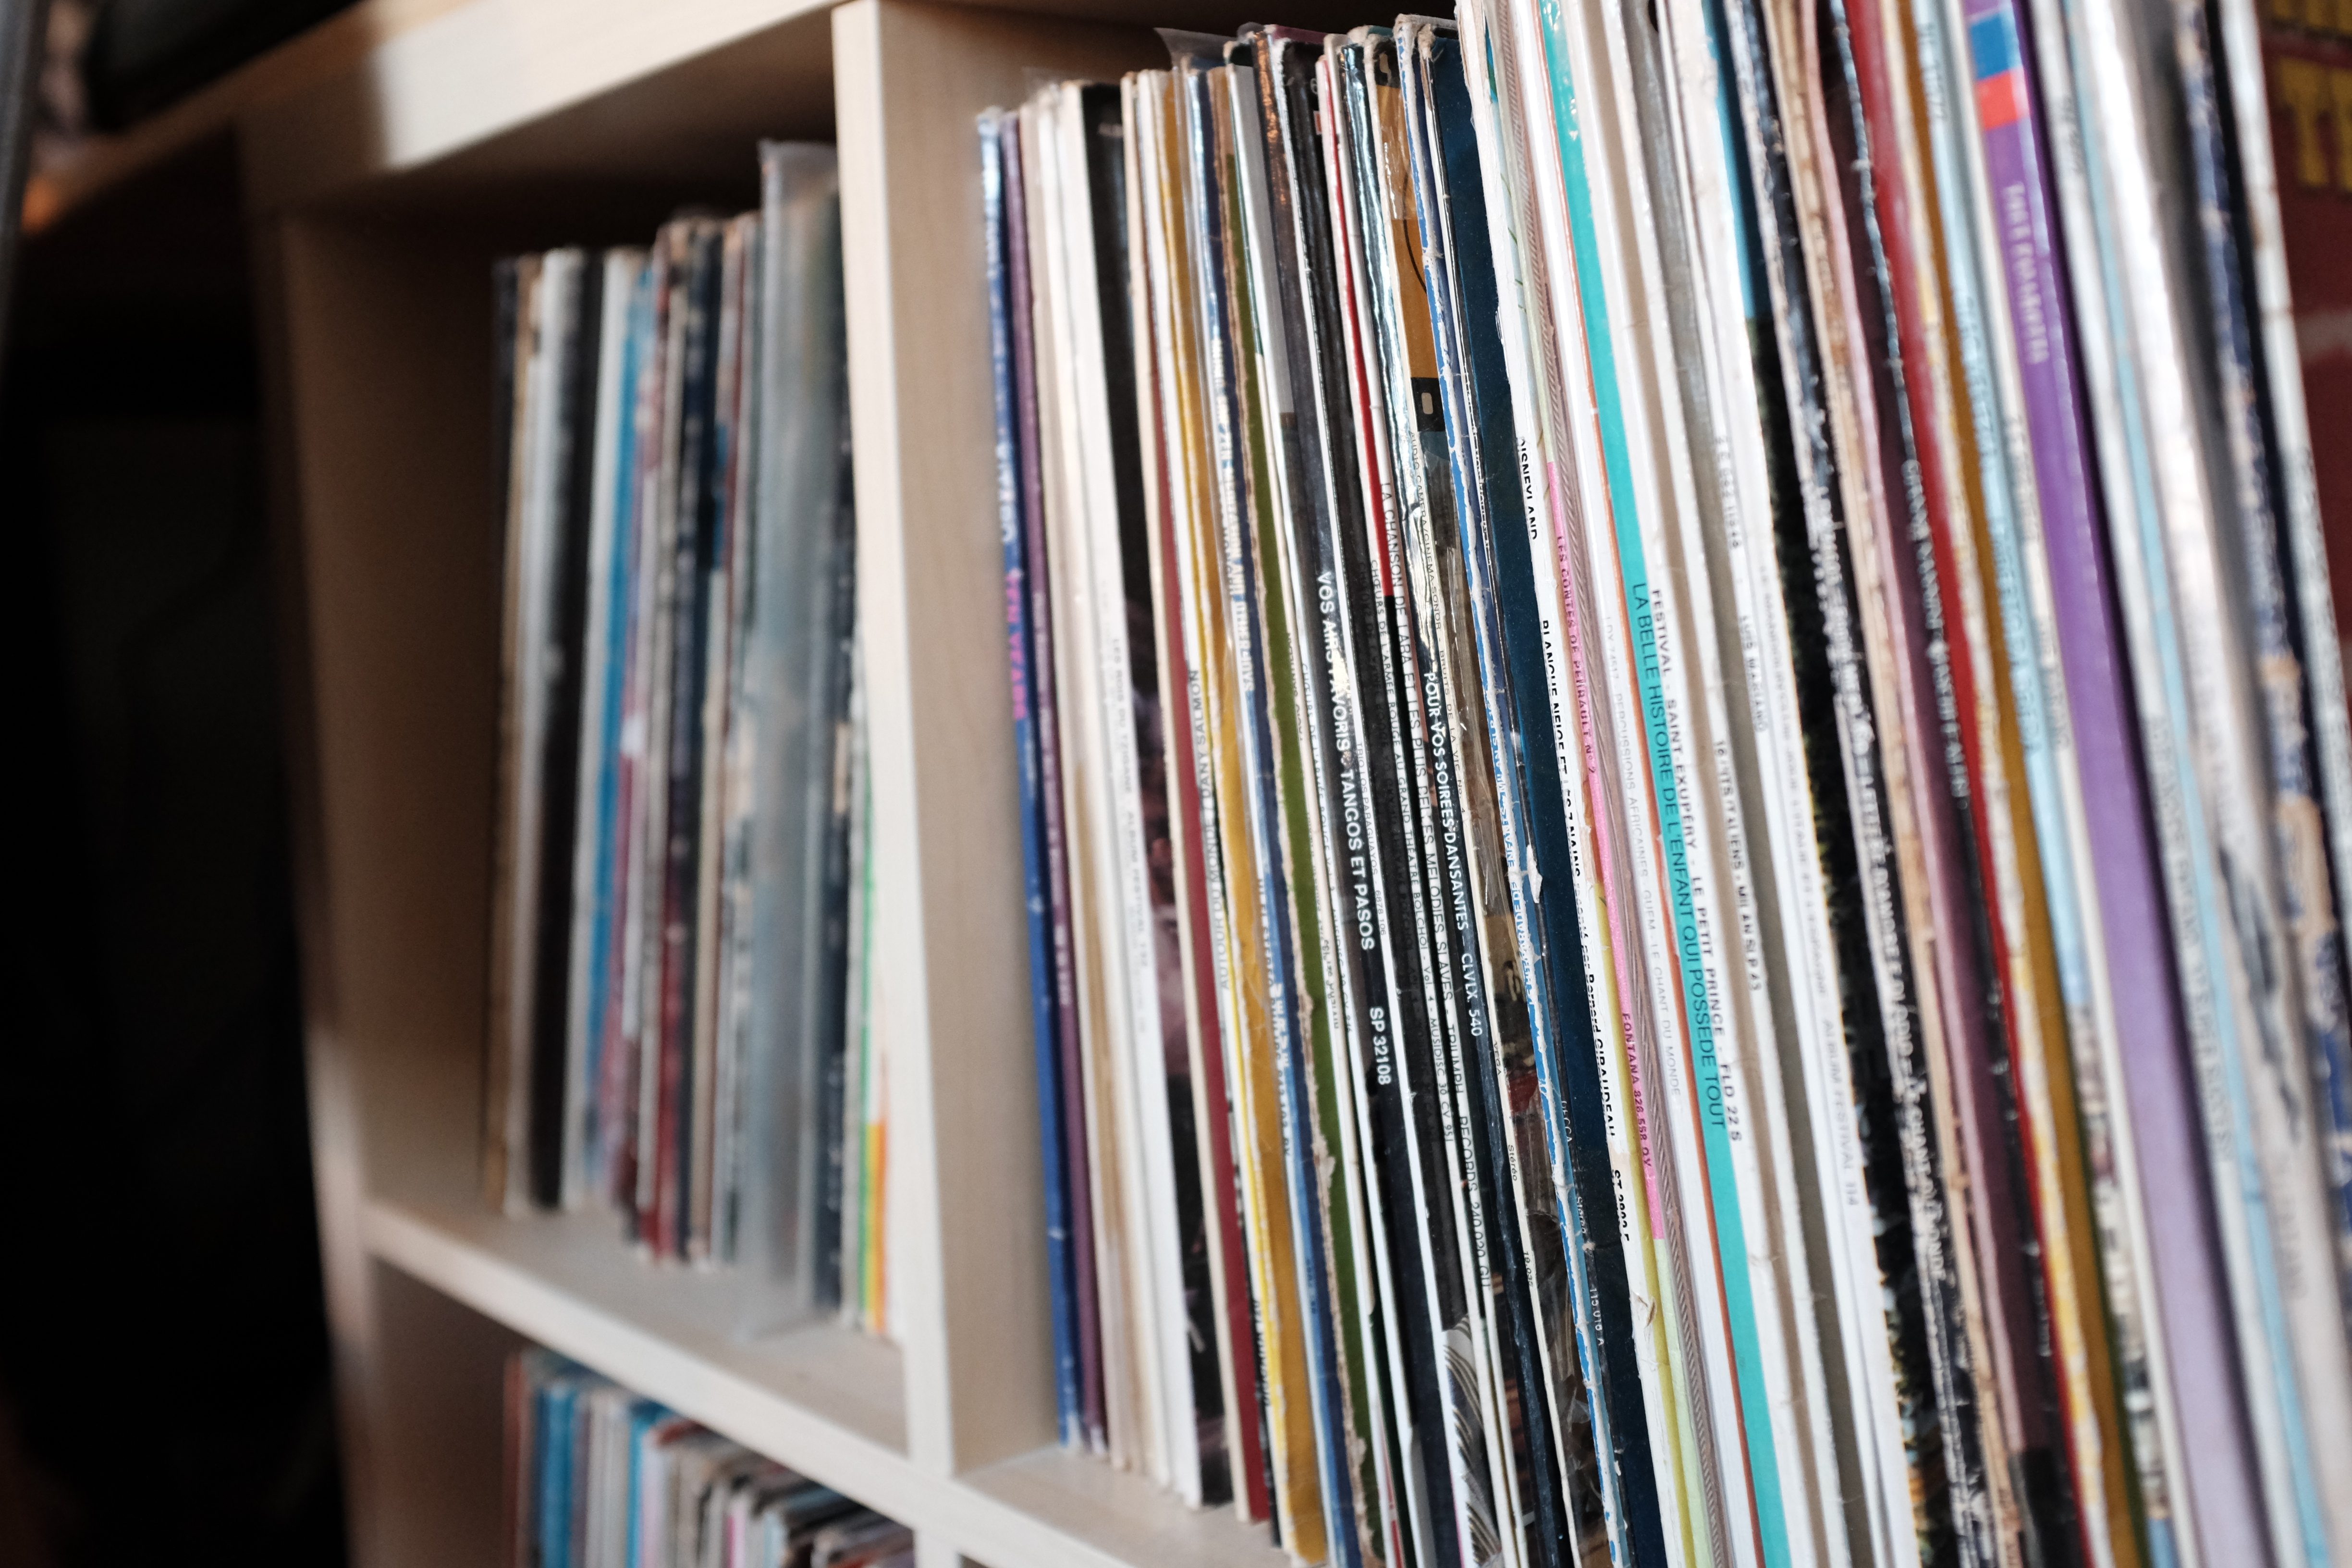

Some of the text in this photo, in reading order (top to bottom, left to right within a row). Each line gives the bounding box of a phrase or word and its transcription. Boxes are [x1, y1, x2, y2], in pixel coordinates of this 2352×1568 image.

[1380, 482, 1391, 502] LA
[1382, 510, 1403, 587] CHANSON
[1557, 535, 1567, 562] LES
[1314, 571, 1335, 613] VOS
[1394, 596, 1406, 616] DE
[1561, 568, 1575, 626] CONTES
[1378, 620, 1388, 636] DE
[1397, 625, 1413, 664] LARA
[1569, 635, 1579, 652] DE
[1652, 588, 1672, 673] FESTIVAL
[1404, 673, 1416, 692] ET
[1423, 672, 1440, 717] POUR
[1440, 650, 1450, 695] BRUITS
[1446, 704, 1453, 720] DE
[1450, 727, 1456, 743] LA
[1573, 659, 1590, 736] PERRAULT
[1389, 701, 1402, 747] ROUGE
[1407, 700, 1421, 729] LES
[1395, 752, 1406, 770] AU
[1411, 737, 1427, 776] PLUS
[1430, 722, 1446, 758] VOS
[1613, 692, 1636, 789] PERCUSSIONS
[1339, 769, 1363, 850] TANGOS
[1397, 776, 1413, 823] GRAND
[1434, 760, 1455, 828] SOIREES
[1190, 671, 1229, 990] AUTOUR DU MONDE DANY SALMON
[1355, 742, 1365, 768] TRIO
[1362, 796, 1379, 875] PARAGUAYOS
[1378, 918, 1386, 936] 106
[1540, 620, 1557, 696] BLANCHE
[1557, 756, 1567, 774] ET
[1586, 973, 1601, 1032] Bernard
[1628, 796, 1649, 877] AFRICAINES
[1350, 856, 1366, 877] ET
[1633, 582, 1726, 1130] LA BELLE HISTOIRE DE L'ENFANT QUI POSSEDE TOUT
[1423, 852, 1446, 933] MELODIES
[1444, 831, 1469, 930] DANSANTES
[1691, 875, 1704, 895] LE
[1353, 882, 1376, 950] PASOS
[1411, 891, 1430, 949] BOLCHOI
[1696, 906, 1713, 957] PETIT
[1435, 941, 1455, 1001] SLAVES
[1654, 966, 1668, 1012] CHANT
[1468, 1008, 1483, 1037] 540
[1705, 967, 1725, 1036] PRINCE
[1369, 1006, 1393, 1085] SP 32108
[1429, 1017, 1446, 1076] MUSIDISC
[1622, 1012, 1640, 1083] FONTANA
[1661, 1019, 1672, 1039] DU
[1492, 1041, 1502, 1076] VEGA
[1665, 1045, 1680, 1096] MONDE
[1720, 1062, 1734, 1098] FLD
[1438, 1082, 1449, 1095] 30
[1440, 1101, 1451, 1117] CV
[1561, 1100, 1572, 1141] DECCA
[1727, 1105, 1739, 1125] 22
[1507, 1144, 1519, 1181] Stéréo
[1523, 1250, 1534, 1286] 19.035
[1597, 1337, 1605, 1346] A
